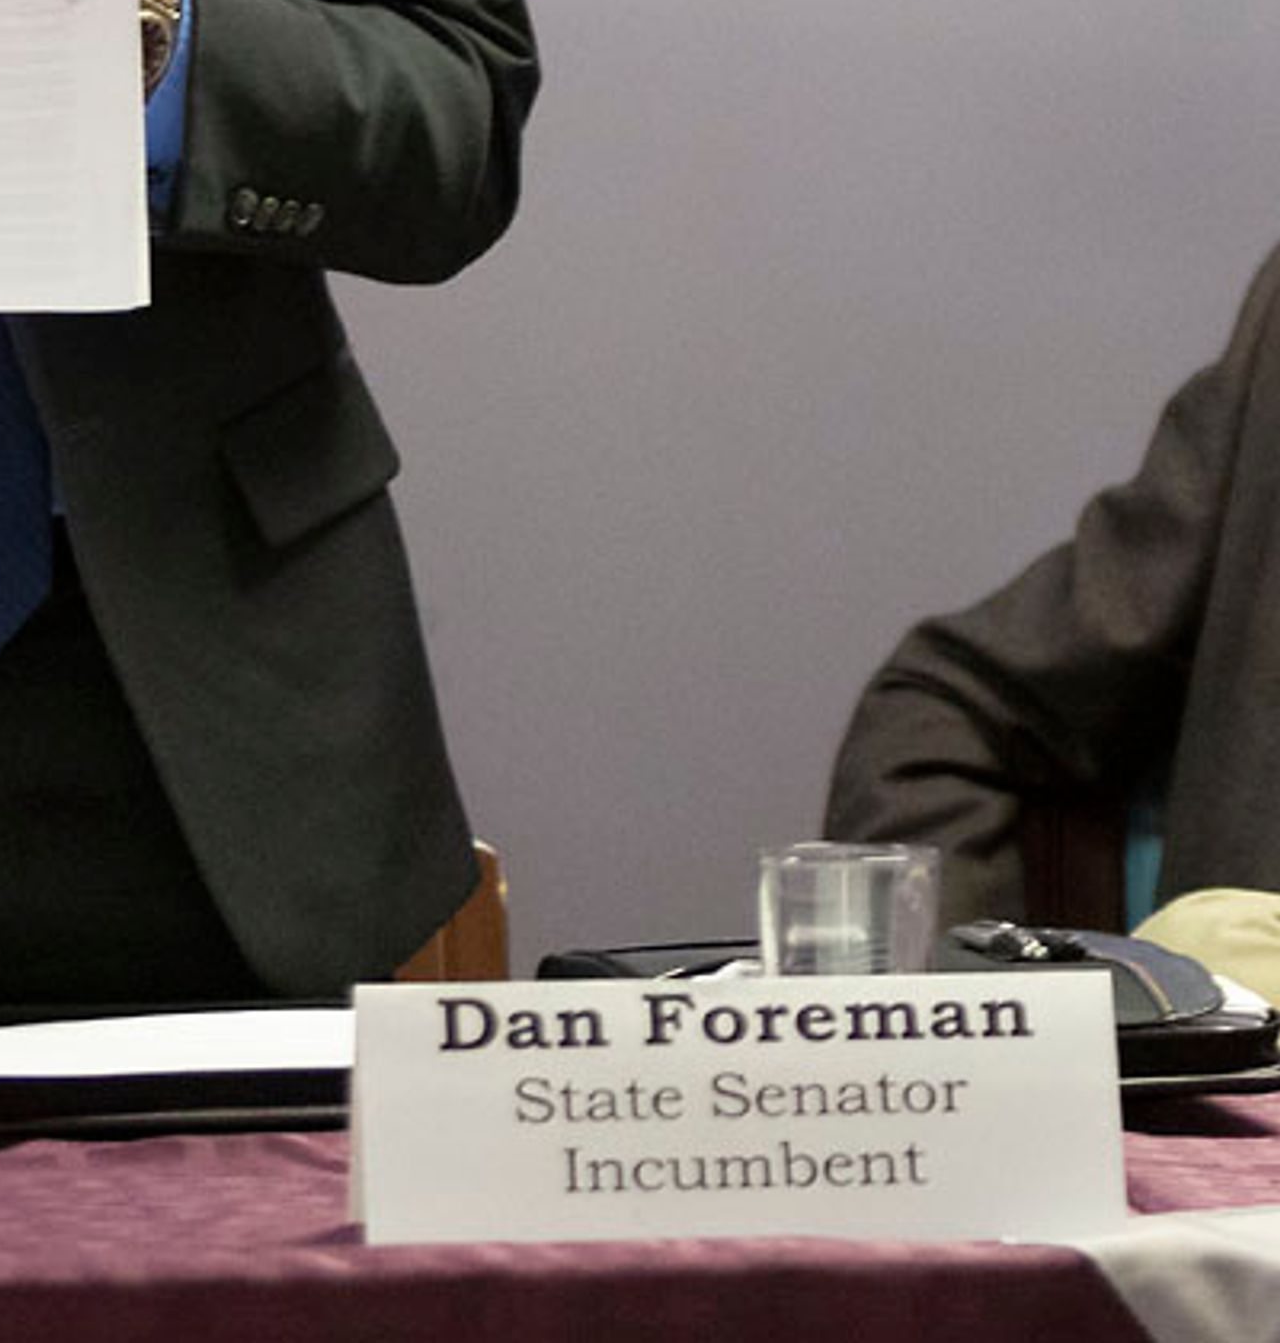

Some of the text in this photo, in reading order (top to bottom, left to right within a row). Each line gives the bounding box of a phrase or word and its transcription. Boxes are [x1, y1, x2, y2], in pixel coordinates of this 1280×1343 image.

[435, 992, 1035, 1053] Dan Foreman
[513, 1070, 969, 1125] State Senator
[562, 1139, 929, 1194] Incumbent
